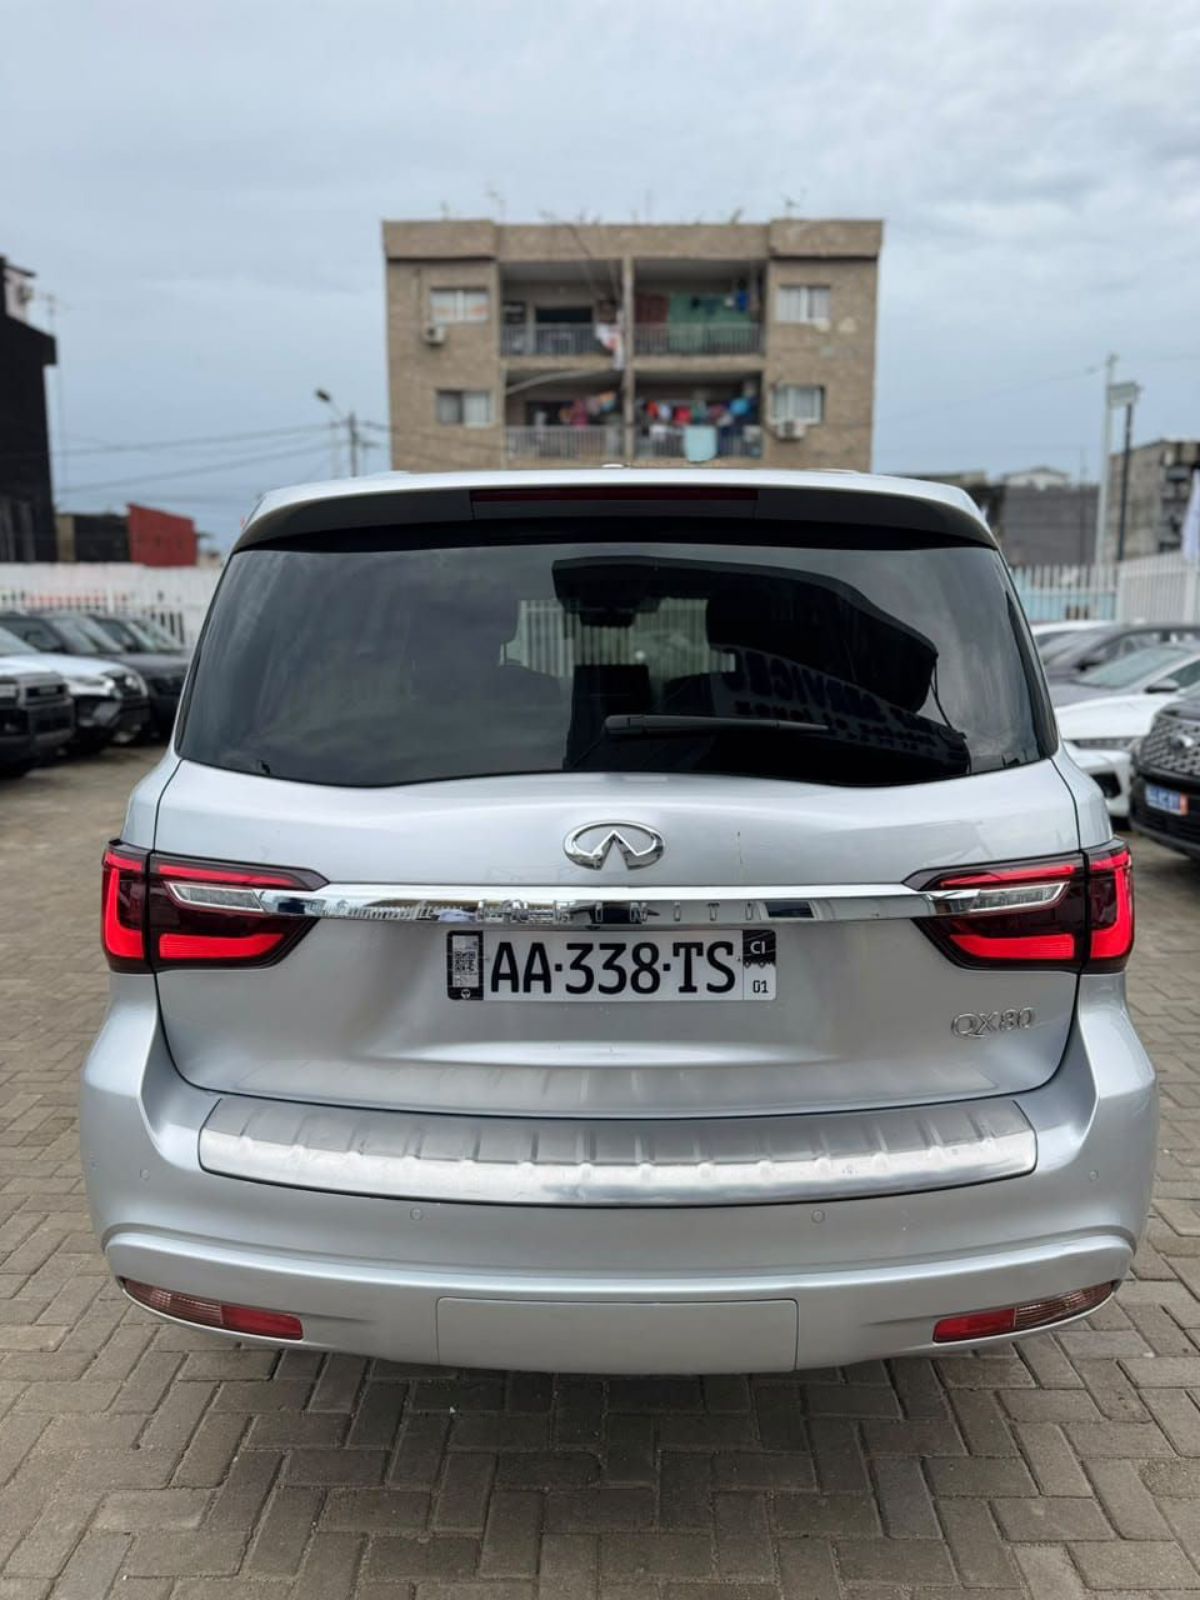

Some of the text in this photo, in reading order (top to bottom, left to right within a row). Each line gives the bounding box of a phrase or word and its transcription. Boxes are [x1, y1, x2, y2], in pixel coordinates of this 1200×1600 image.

[750, 940, 766, 954] CI
[752, 979, 769, 993] 01
[950, 1006, 1034, 1038] QX80
